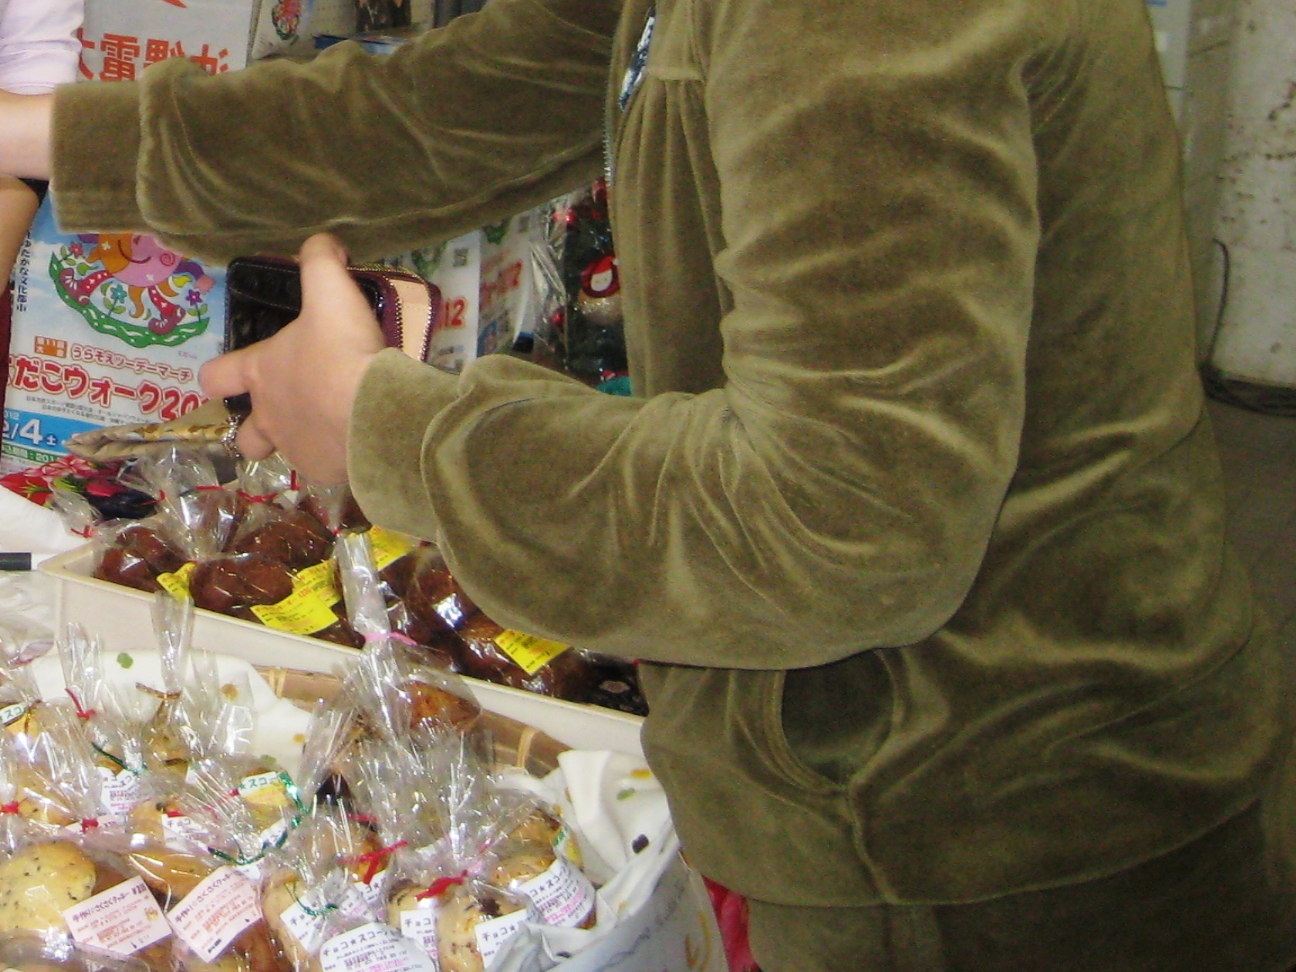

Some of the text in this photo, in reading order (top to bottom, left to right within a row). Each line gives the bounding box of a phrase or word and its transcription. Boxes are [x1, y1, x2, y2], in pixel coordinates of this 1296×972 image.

[7, 356, 210, 422] だこウォーク20
[71, 343, 193, 383] うらそえツーデーマーチ
